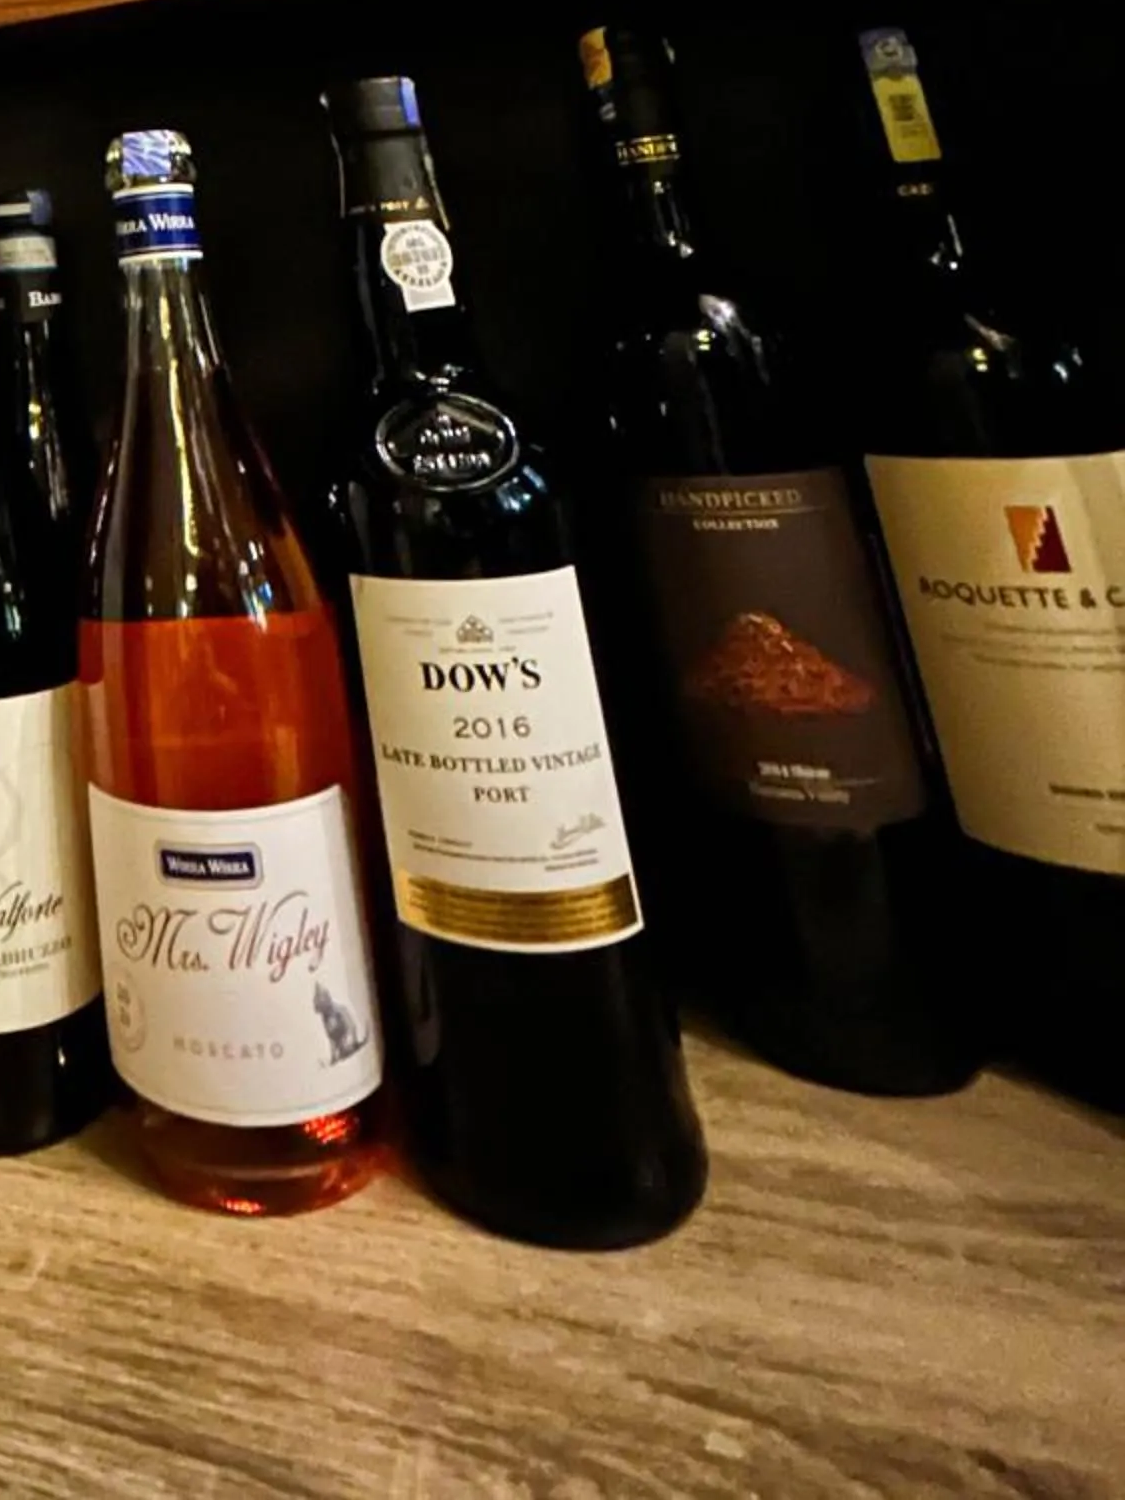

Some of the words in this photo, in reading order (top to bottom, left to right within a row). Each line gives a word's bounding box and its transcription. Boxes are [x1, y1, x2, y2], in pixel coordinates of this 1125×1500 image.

[659, 488, 803, 509] HANDPICKED
[919, 576, 1070, 610] ROQUETTE
[1080, 587, 1097, 609] &
[420, 656, 542, 693] DOW'S
[453, 716, 532, 740] 2016
[381, 743, 426, 768] LATE
[429, 750, 527, 774] BOTTLED
[531, 743, 603, 772] VINTAGE
[473, 786, 531, 803] PORT
[166, 855, 206, 876] WIRRA
[207, 857, 250, 875] WIRRA
[207, 889, 330, 983] Wigley
[173, 1036, 285, 1061] MOSCATO
